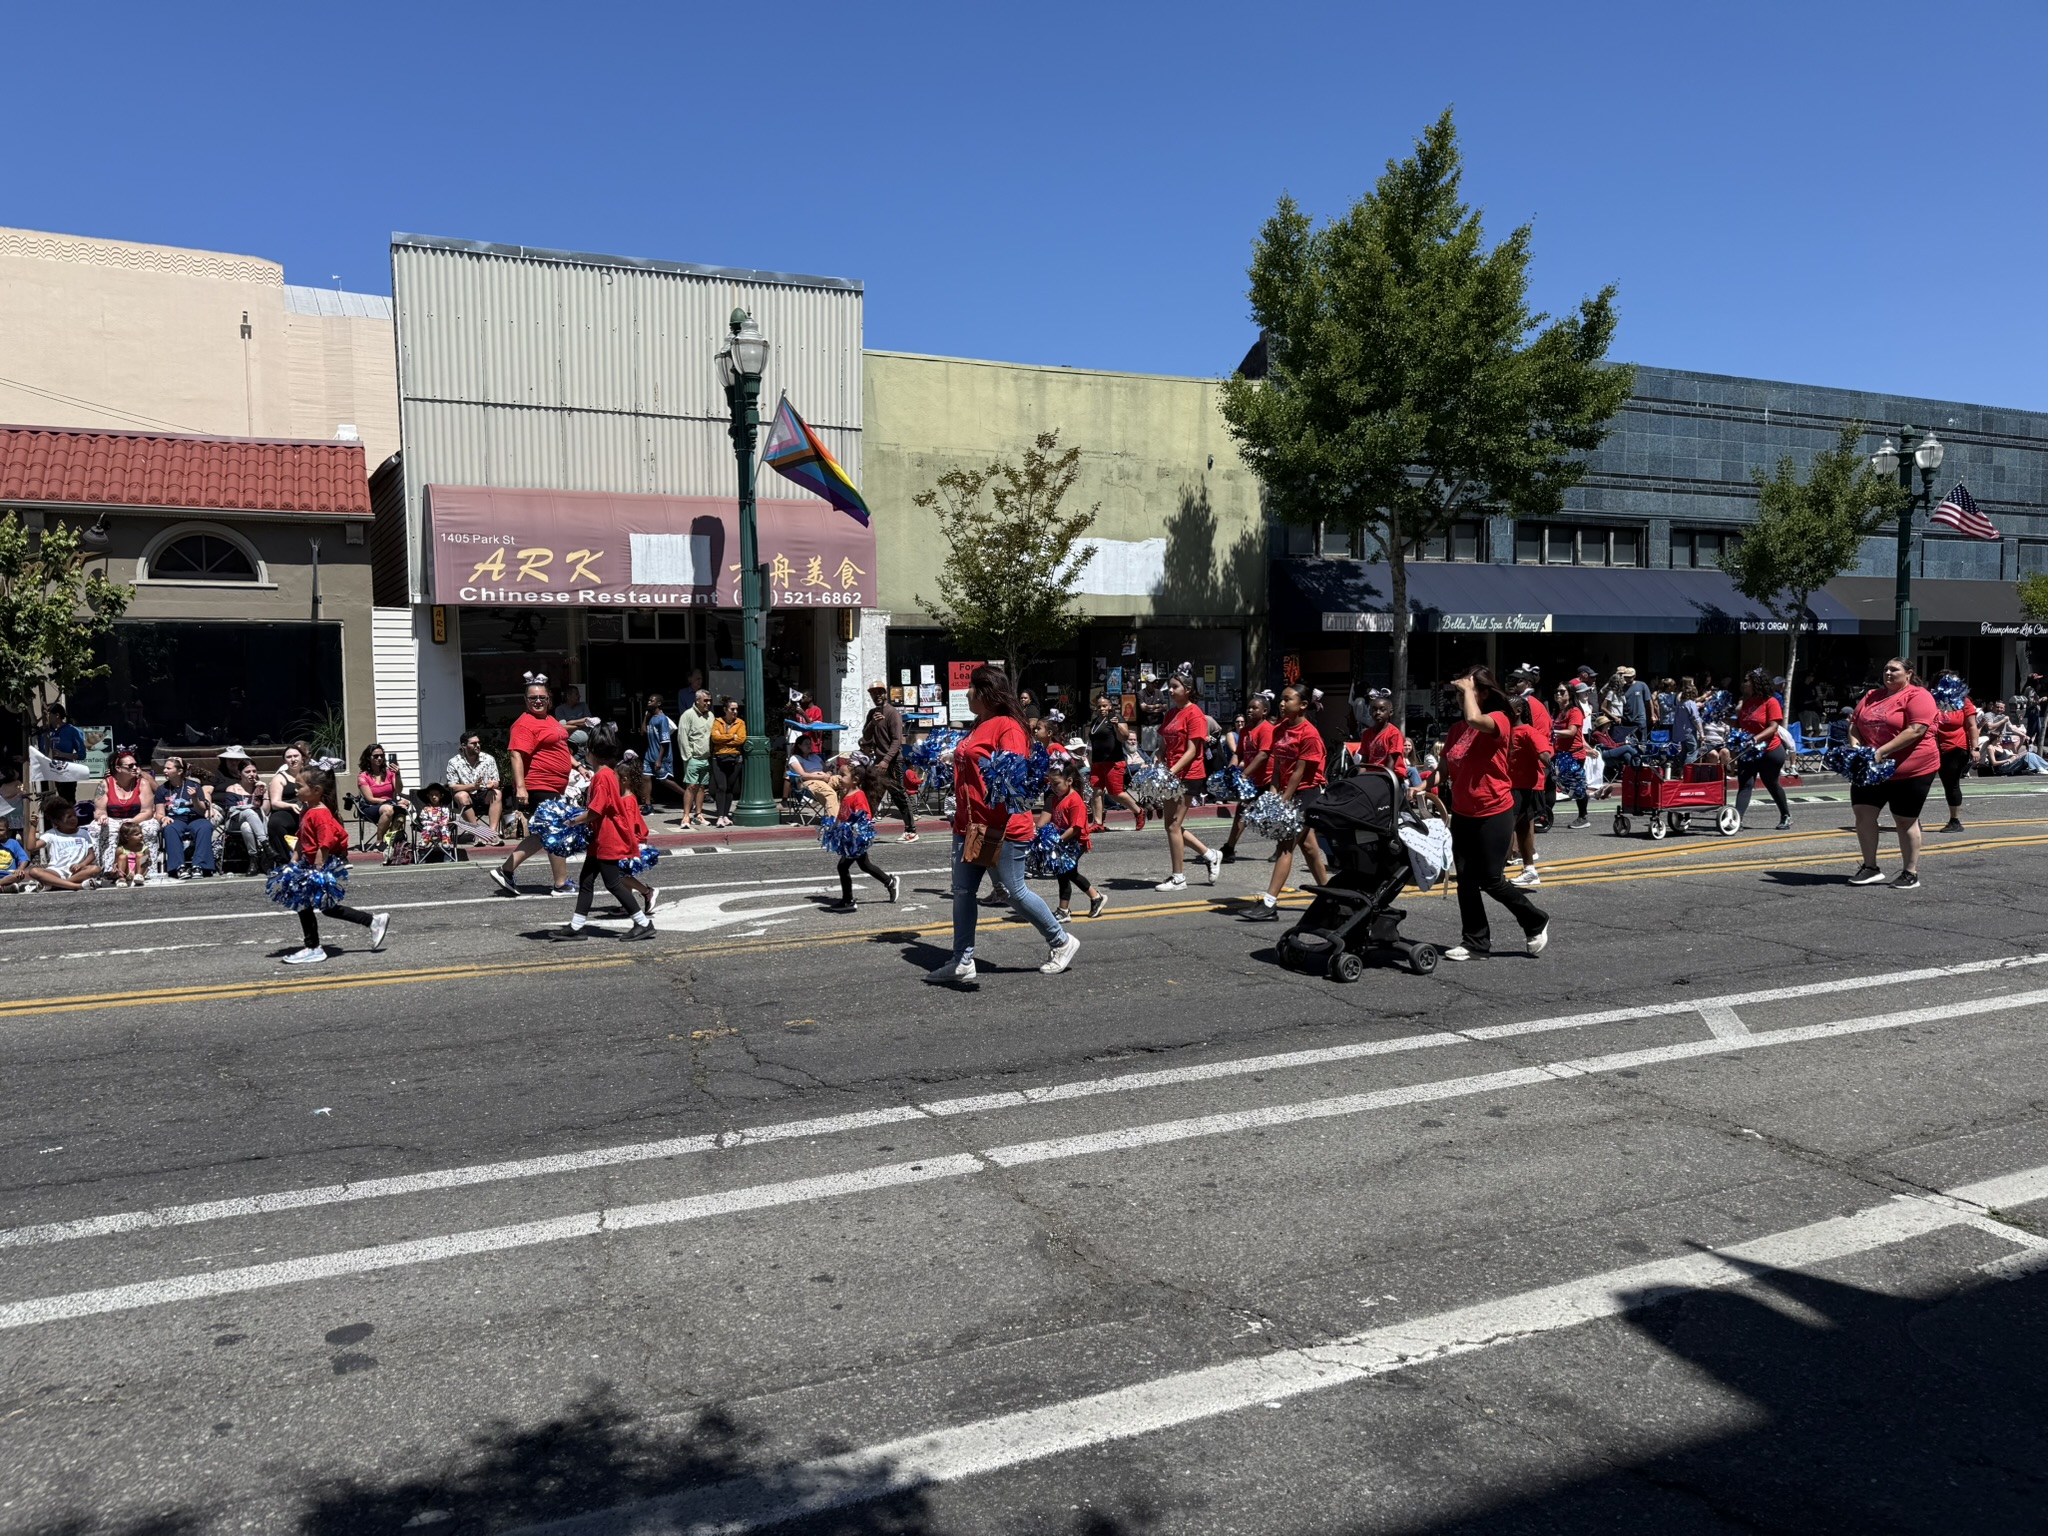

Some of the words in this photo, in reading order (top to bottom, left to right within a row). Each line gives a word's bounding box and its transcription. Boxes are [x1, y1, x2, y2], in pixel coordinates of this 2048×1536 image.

[440, 533, 470, 544] 1405
[472, 534, 500, 545] Park
[502, 535, 515, 545] St
[468, 547, 604, 583] ARK
[459, 587, 570, 603] Chinese
[579, 590, 718, 604] Restaurant
[783, 591, 862, 605] 521-6862
[435, 610, 444, 637] ARK
[1442, 615, 1466, 630] Bella
[1467, 616, 1487, 630] Nail
[1488, 617, 1503, 631] Spa
[1505, 616, 1512, 630] &
[1740, 622, 1765, 631] TOMO'S
[1817, 622, 1828, 631] SPA
[1981, 621, 2019, 636] Triumphant
[959, 663, 974, 671] For
[953, 672, 970, 680] Lea
